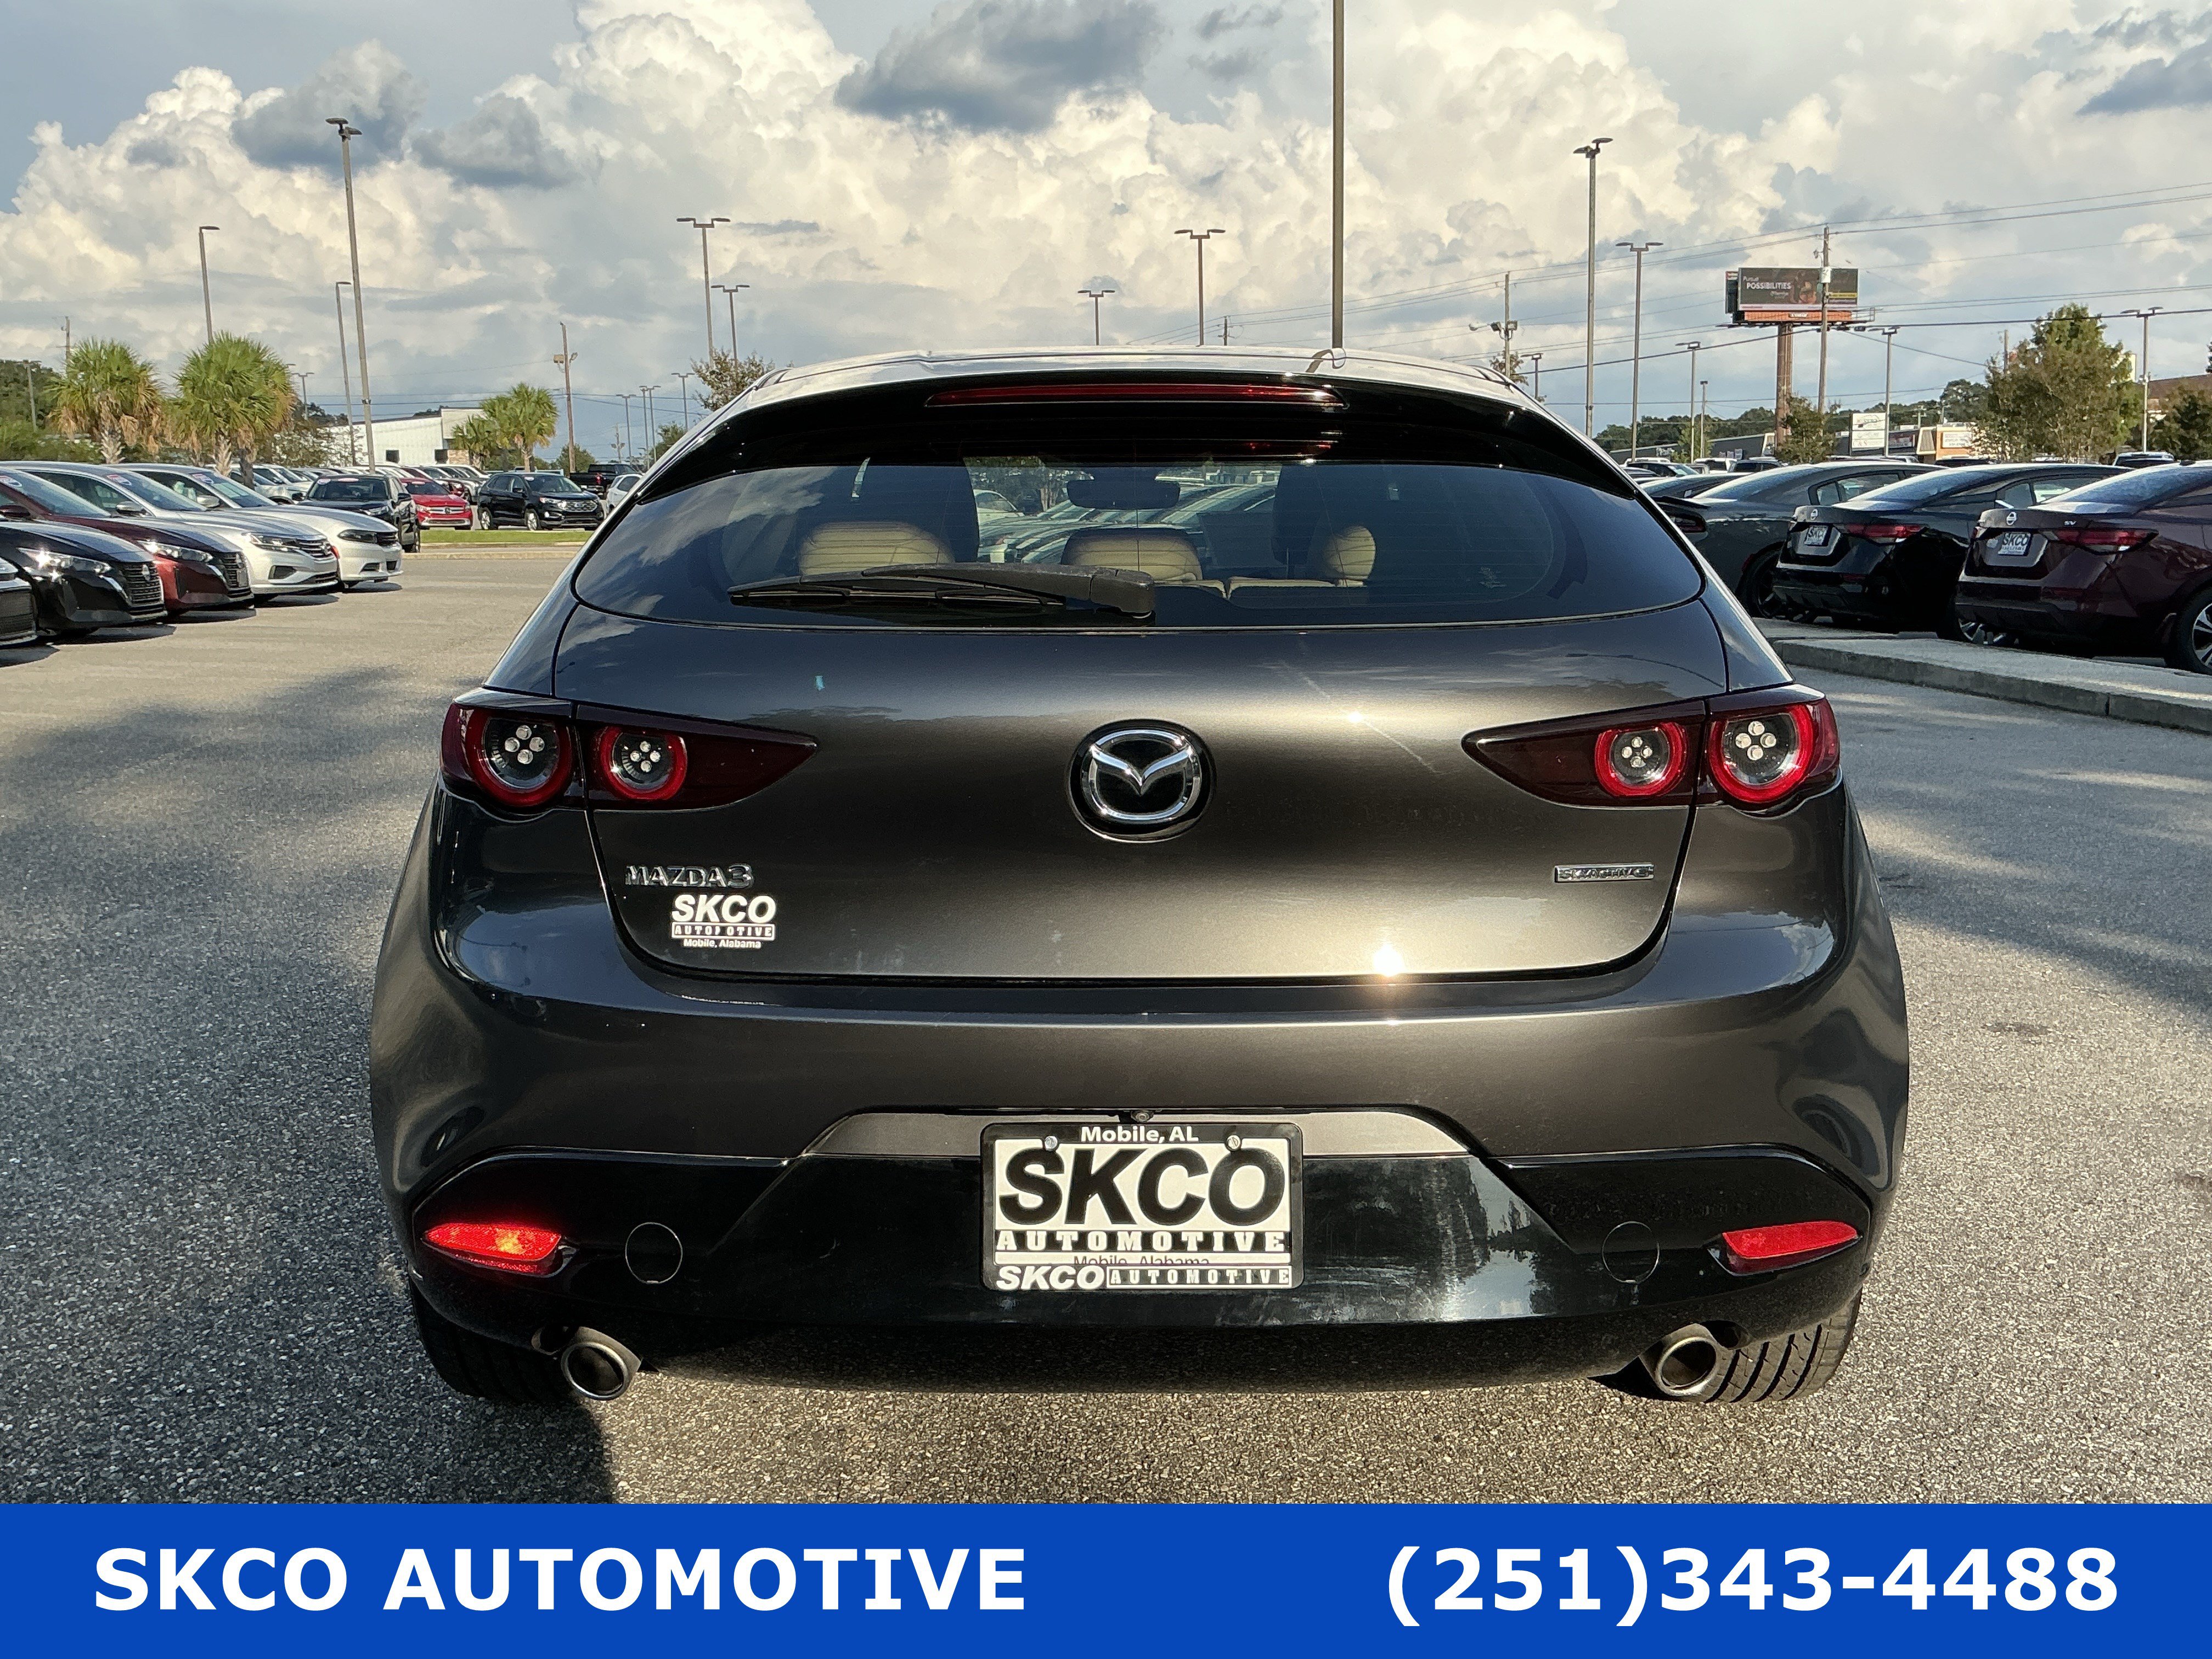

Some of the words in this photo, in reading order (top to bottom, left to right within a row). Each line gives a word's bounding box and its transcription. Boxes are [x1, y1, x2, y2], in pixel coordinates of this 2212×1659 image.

[2002, 533, 2029, 546] SKCO
[625, 864, 754, 889] MAZDA3
[672, 894, 776, 923] SKCO
[684, 939, 718, 948] Mobile,
[719, 939, 761, 949] Alabama
[1081, 1126, 1165, 1144] Mobile,
[1169, 1126, 1199, 1142] AL
[999, 1147, 1285, 1226] SKCO
[996, 1231, 1285, 1251] AUTOMOTIVE
[996, 1265, 1104, 1290] SKCO
[1110, 1269, 1290, 1285] AUTOMOTIVE
